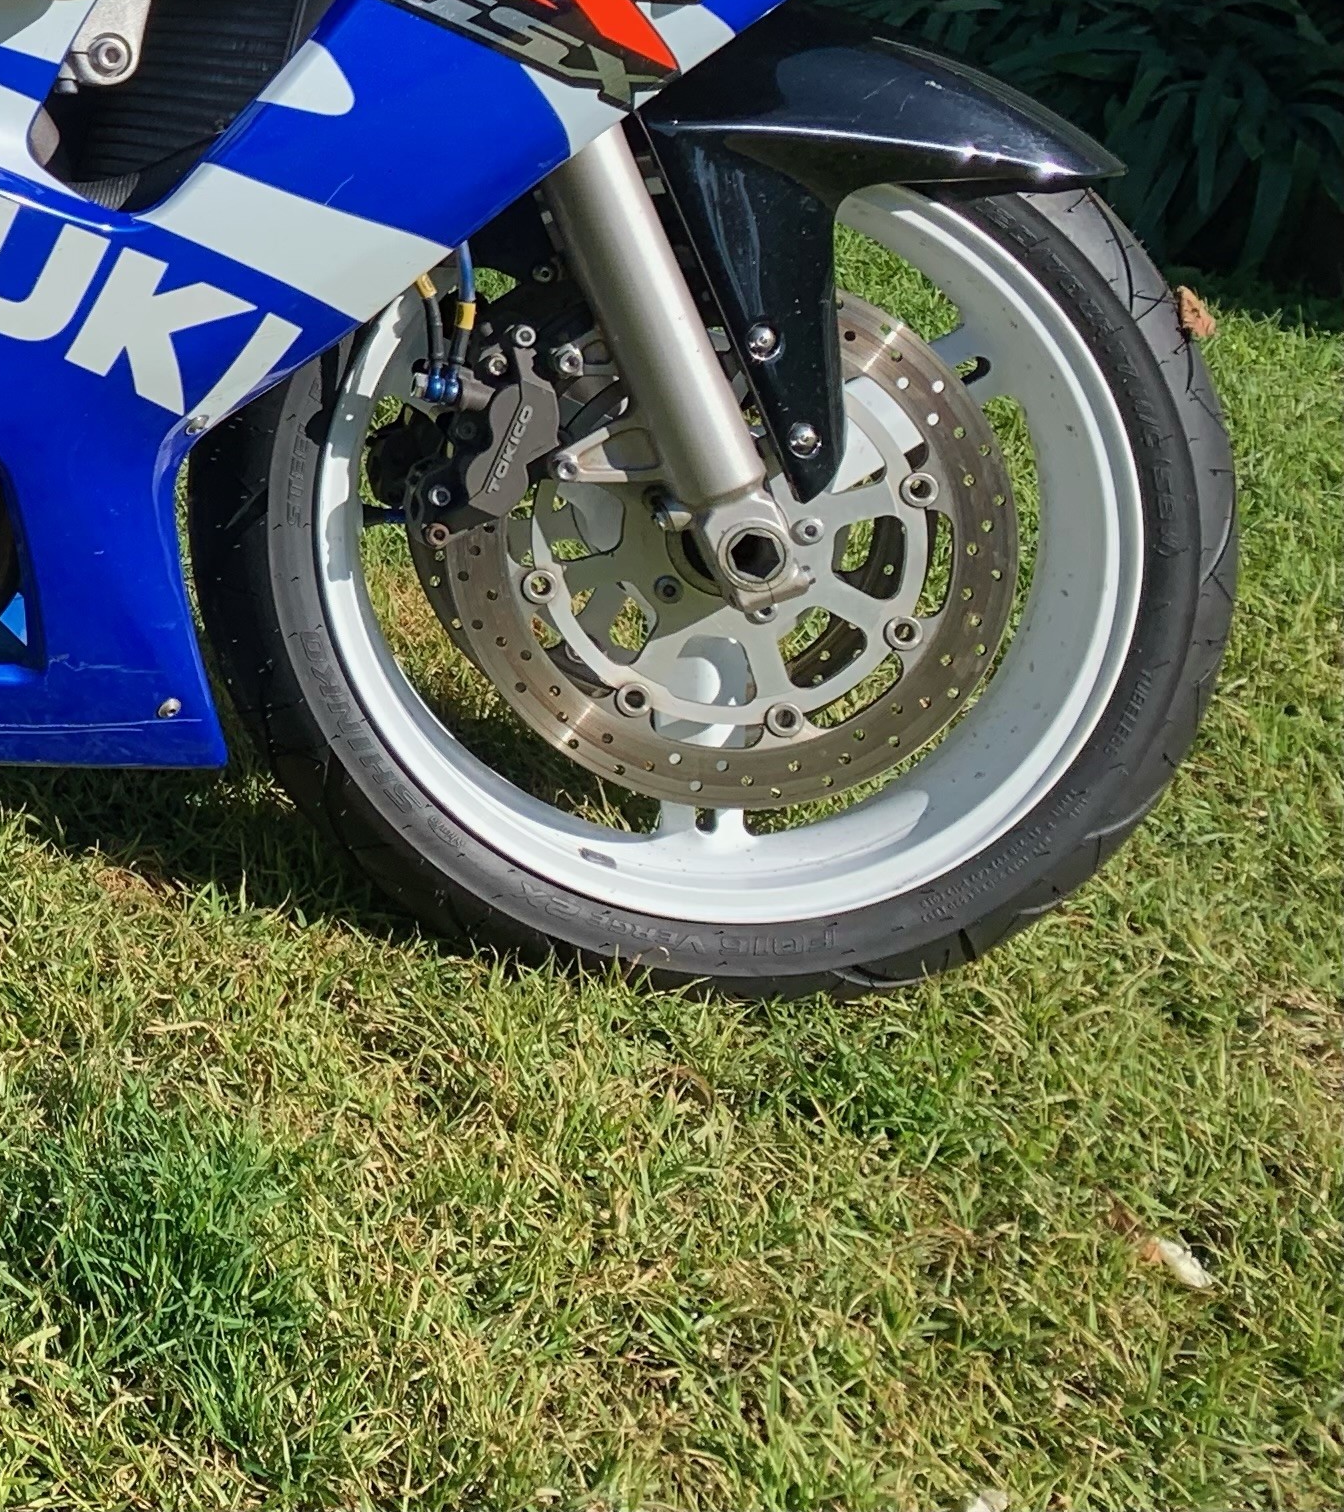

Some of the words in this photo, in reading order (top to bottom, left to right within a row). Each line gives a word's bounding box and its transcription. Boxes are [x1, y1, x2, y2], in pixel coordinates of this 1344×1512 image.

[485, 404, 533, 495] TOKICO
[299, 630, 425, 814] SHINKO
[1103, 669, 1153, 757] TUBELESS
[587, 909, 706, 955] VERGE
